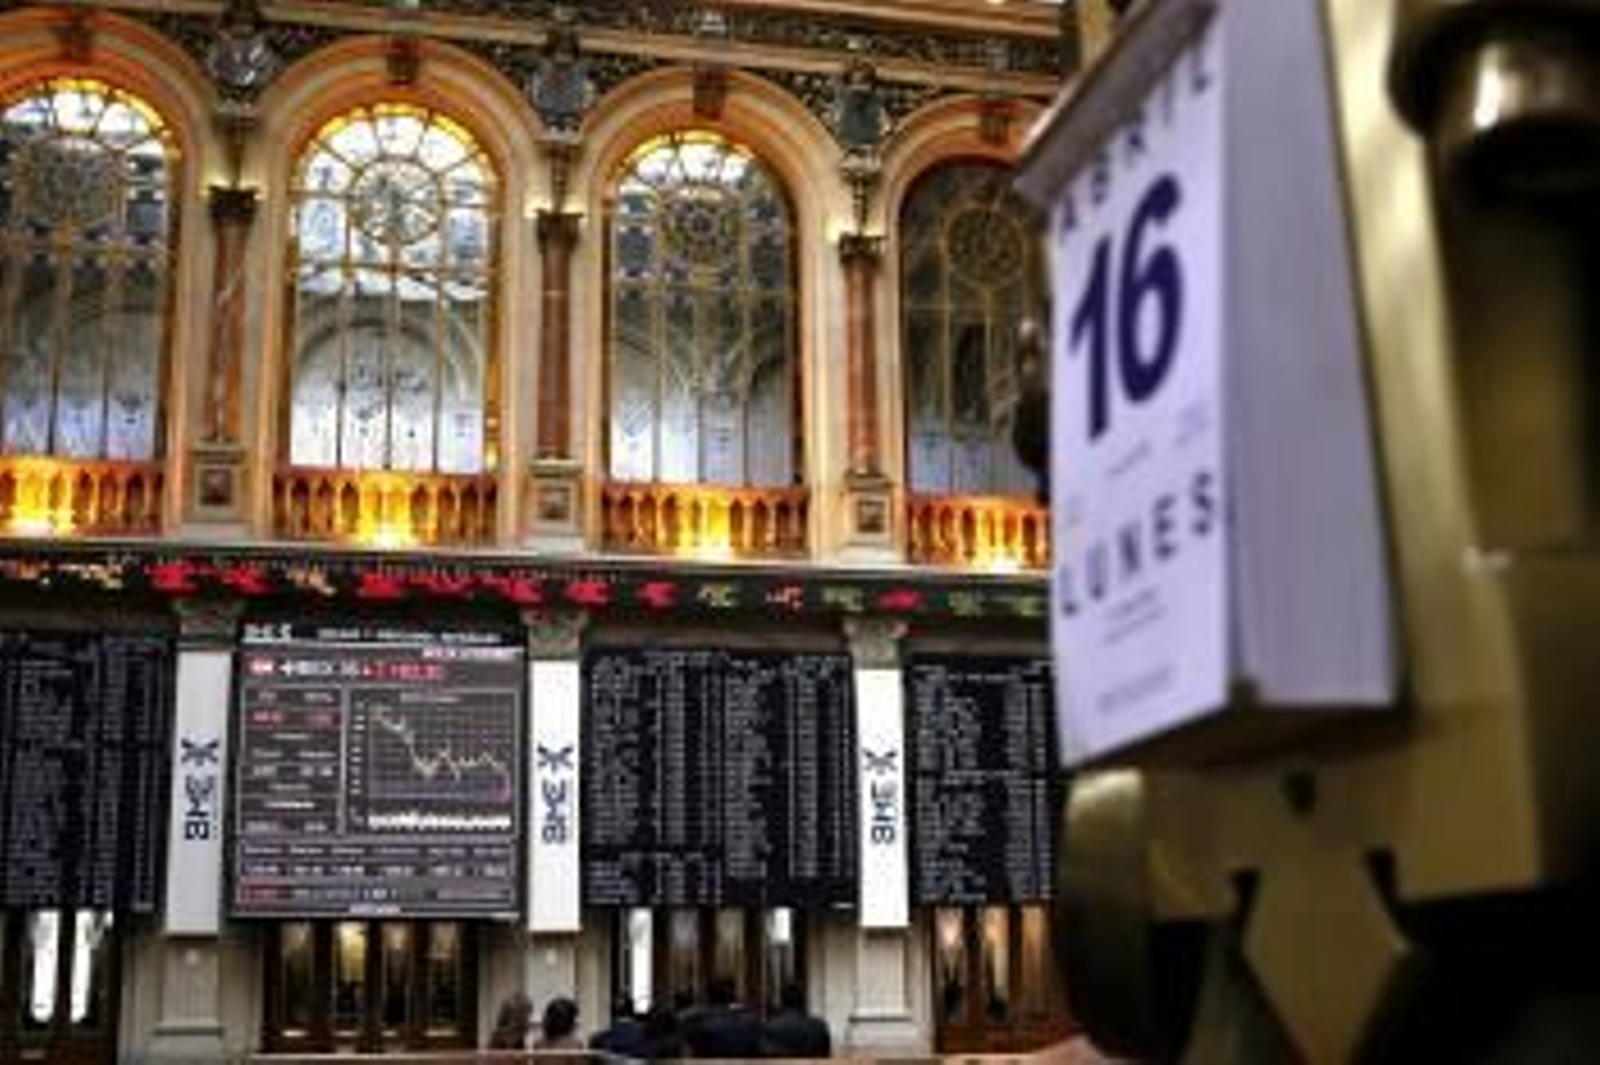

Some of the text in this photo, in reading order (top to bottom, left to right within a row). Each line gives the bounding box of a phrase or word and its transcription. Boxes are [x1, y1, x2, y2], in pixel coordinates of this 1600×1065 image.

[1068, 172, 1182, 444] 16
[1058, 472, 1212, 617] LUNES
[183, 775, 214, 841] BME
[541, 779, 567, 844] BME
[870, 781, 898, 845] BME
